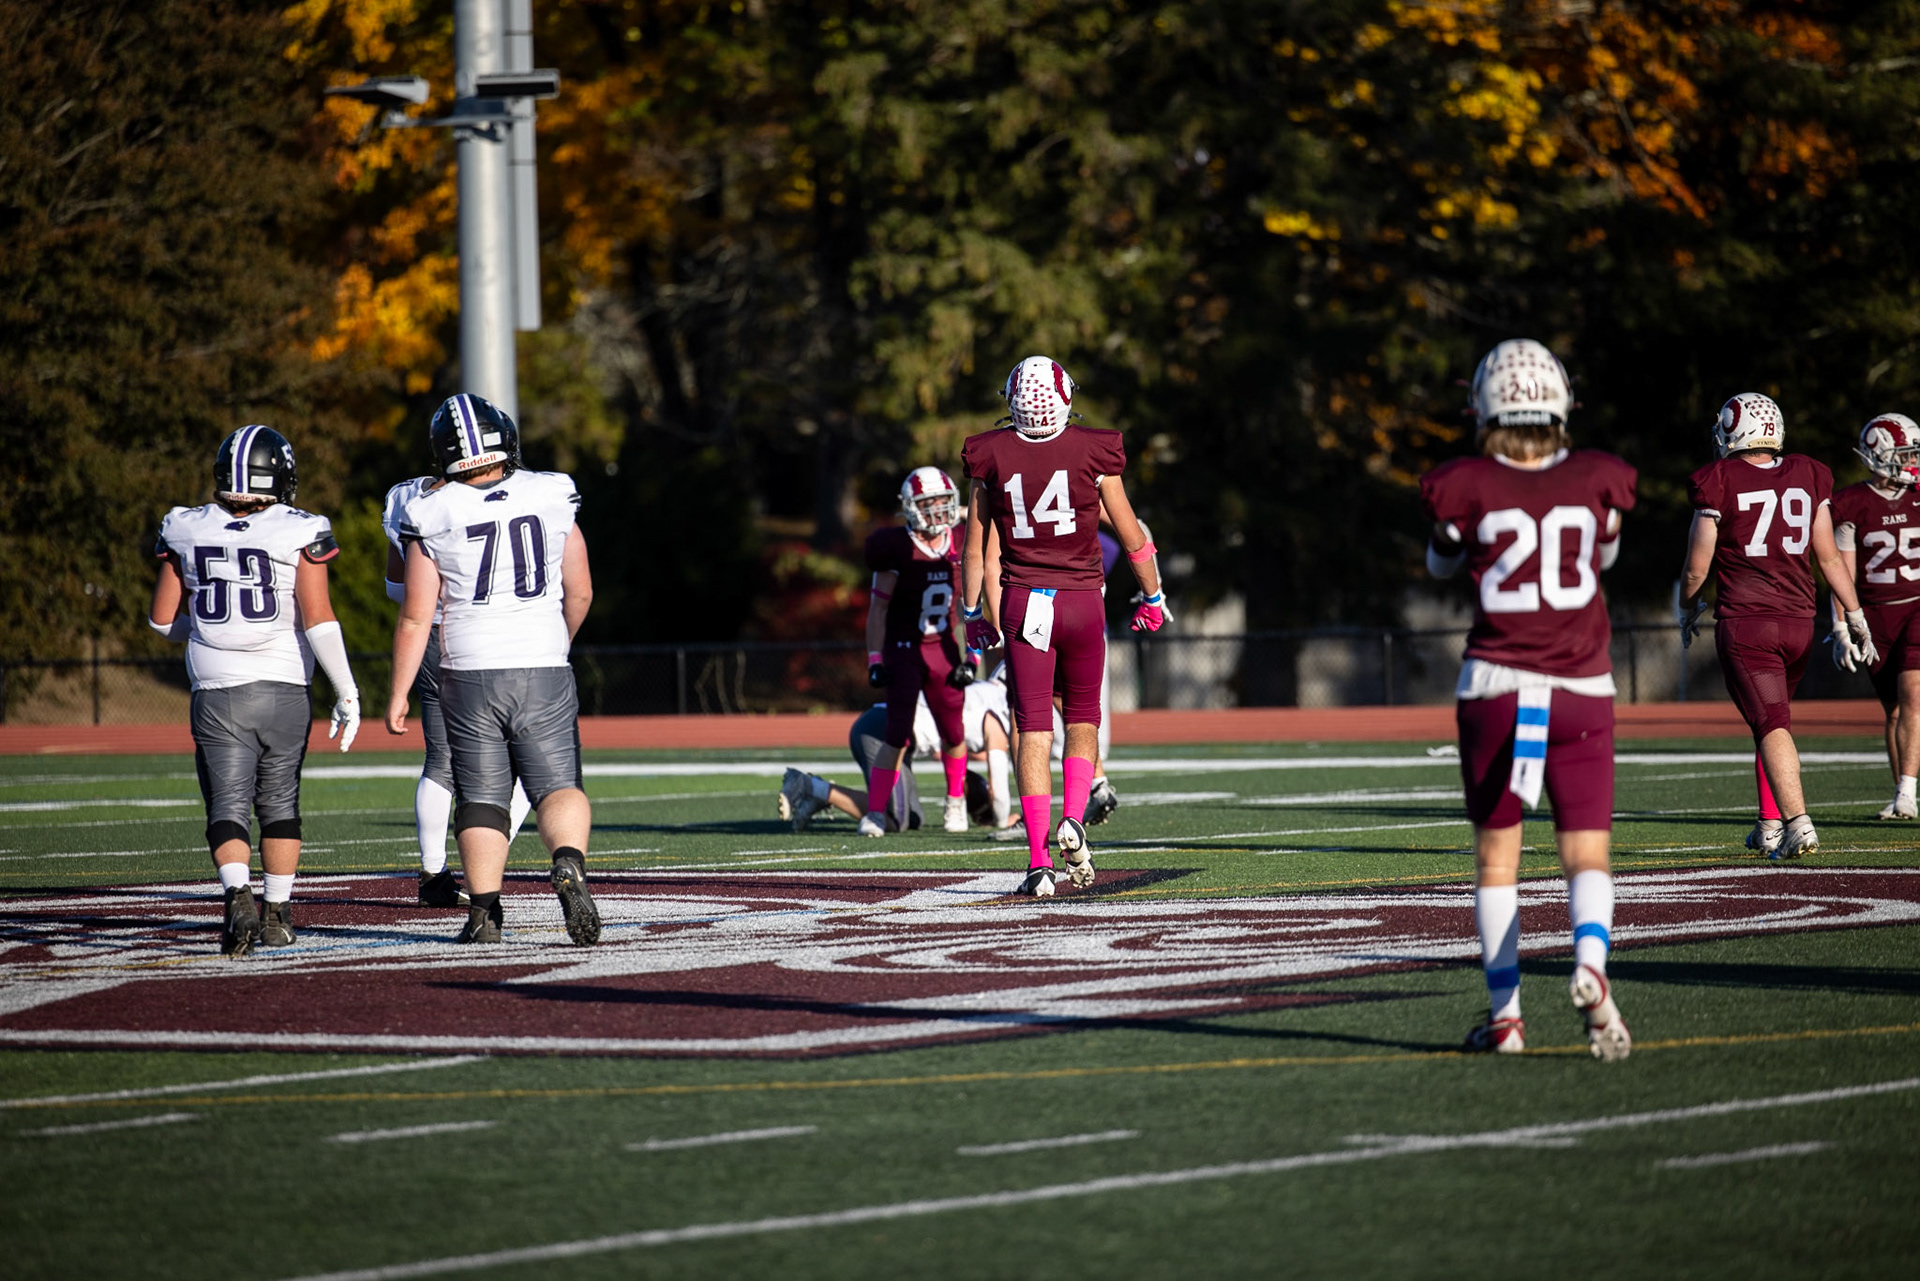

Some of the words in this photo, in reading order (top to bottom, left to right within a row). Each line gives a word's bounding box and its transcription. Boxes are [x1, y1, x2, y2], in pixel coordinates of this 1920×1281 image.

[1030, 416, 1049, 427] 14
[1762, 422, 1775, 436] 79
[458, 453, 497, 469] Riddell
[1004, 470, 1077, 539] 14
[1737, 487, 1811, 557] 79
[1882, 513, 1908, 525] RAMS
[466, 514, 549, 605] 70
[1477, 505, 1598, 613] 20
[1862, 526, 1920, 584] 25
[194, 545, 280, 624] 53
[919, 583, 953, 635] 8
